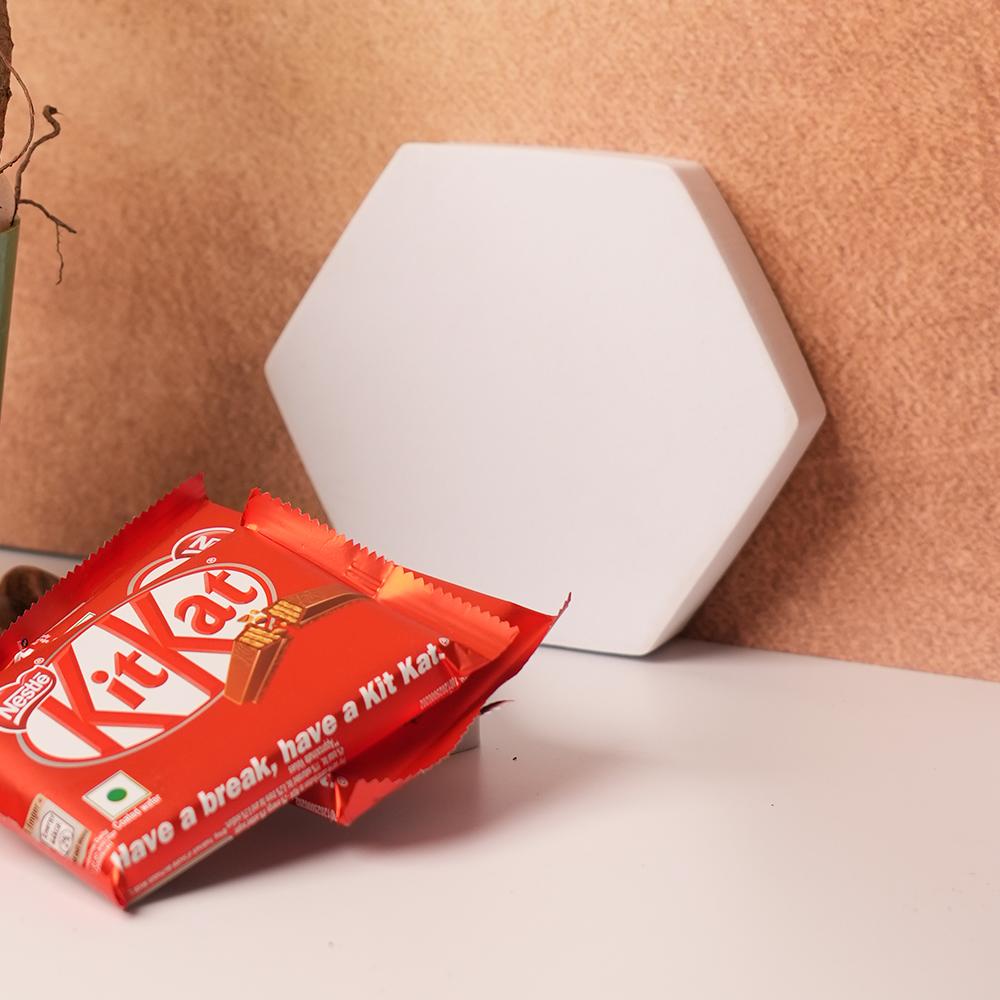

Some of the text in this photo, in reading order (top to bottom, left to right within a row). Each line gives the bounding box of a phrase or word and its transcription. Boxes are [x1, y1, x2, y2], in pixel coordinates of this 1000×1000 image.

[179, 805, 198, 832] a
[196, 755, 278, 818] break,
[277, 714, 338, 764] have
[342, 700, 359, 723] a
[358, 671, 398, 711] Kit
[112, 793, 163, 831] Coated wafer
